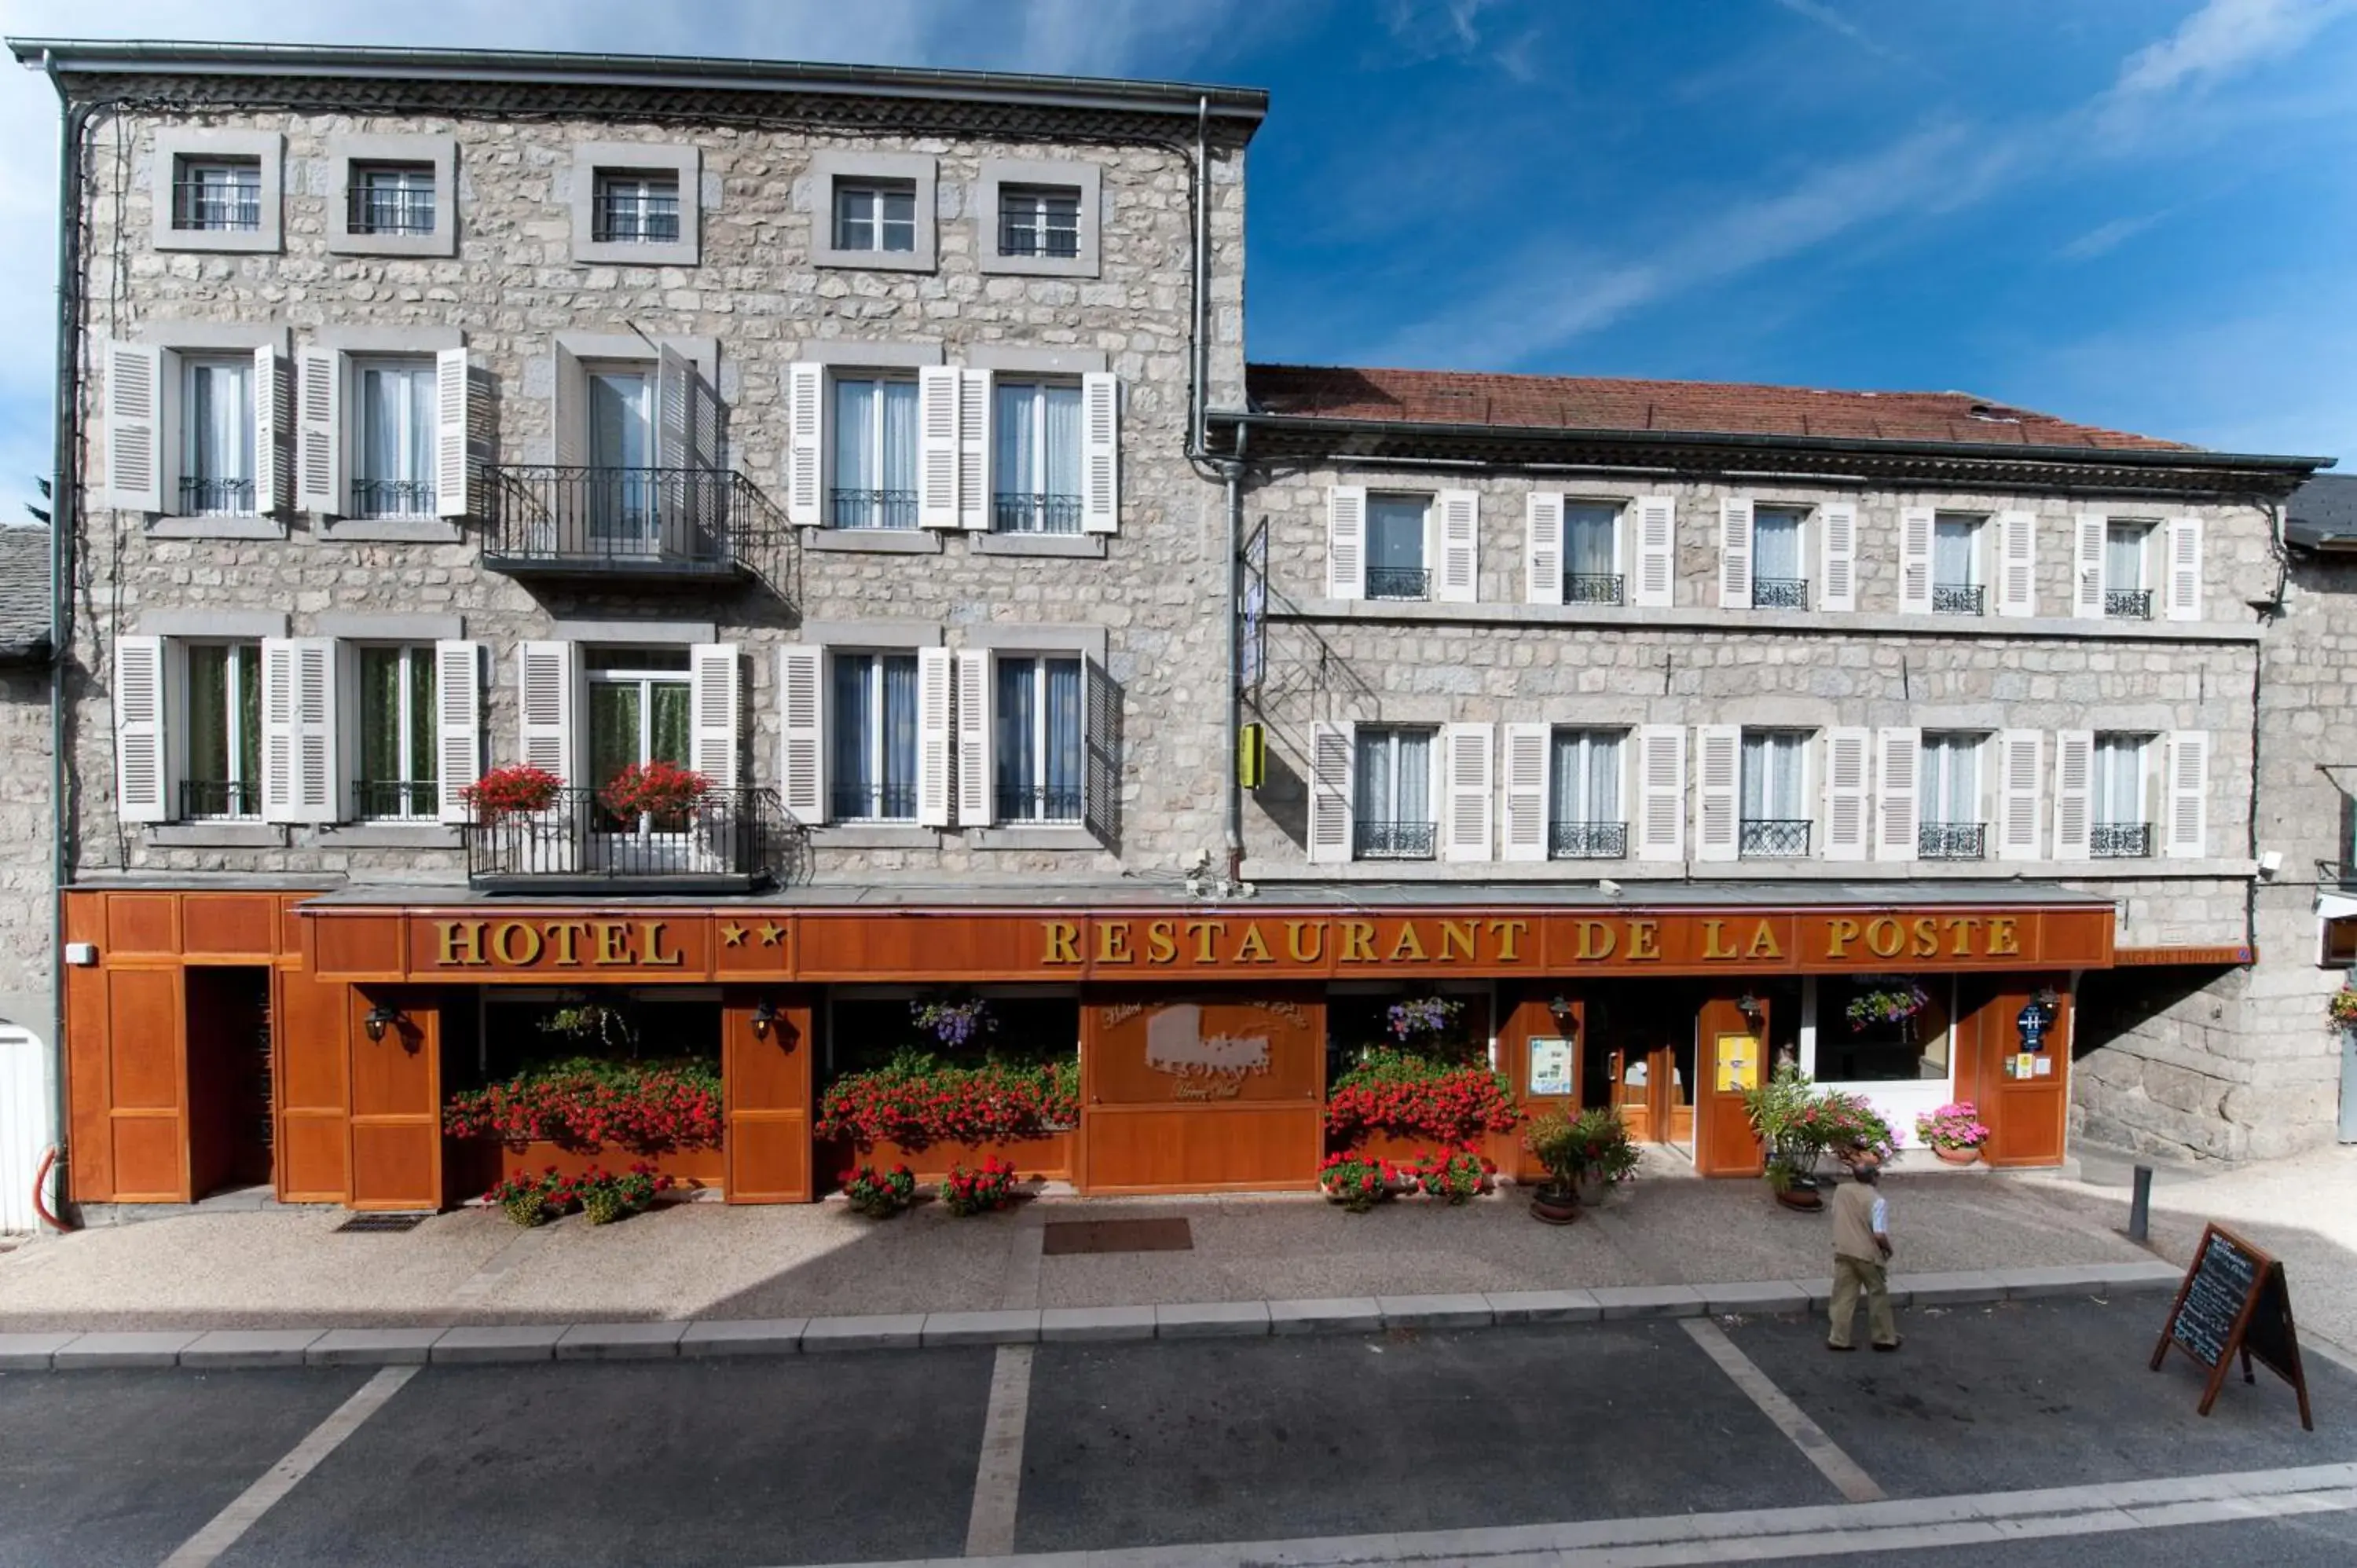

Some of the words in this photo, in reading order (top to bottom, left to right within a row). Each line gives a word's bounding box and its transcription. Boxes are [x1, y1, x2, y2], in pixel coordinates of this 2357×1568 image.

[433, 919, 682, 967] HOTEL
[1040, 919, 1530, 965] RESTAURANT
[1574, 919, 1661, 960] DE
[1703, 918, 1784, 960] LA
[1825, 916, 2021, 958] POSTE
[2027, 1016, 2040, 1030] H
